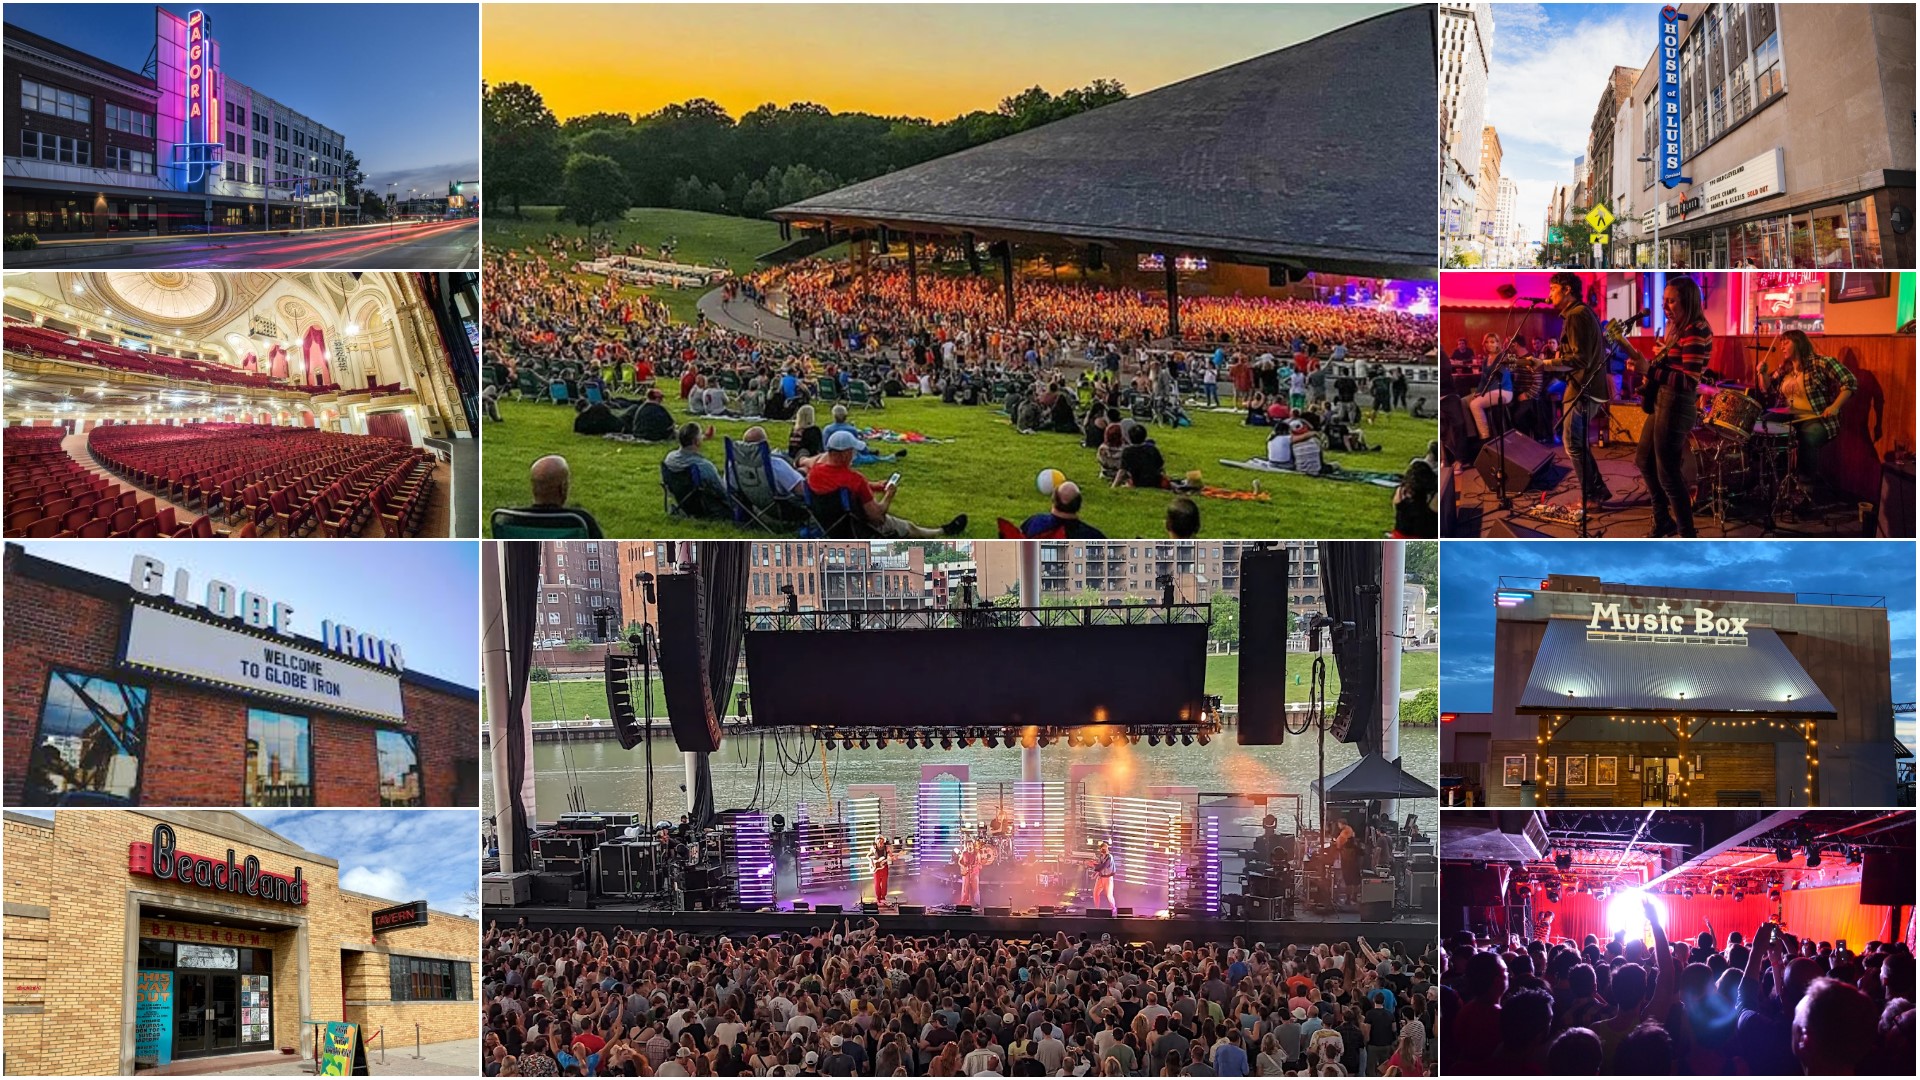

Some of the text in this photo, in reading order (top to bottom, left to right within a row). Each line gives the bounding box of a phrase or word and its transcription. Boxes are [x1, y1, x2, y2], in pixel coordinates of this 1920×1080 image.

[1664, 23, 1677, 84] HOUSE
[190, 27, 202, 118] AGORA
[1666, 102, 1678, 169] BLUES
[1747, 189, 1758, 198] SOLD
[1760, 185, 1768, 193] OUT
[129, 554, 405, 673] GLOBE IRON
[1586, 602, 1749, 635] Music Box
[240, 660, 341, 696] TO GLOBE IRON
[264, 647, 323, 677] WELCOME
[152, 823, 303, 905] Beachland
[375, 909, 415, 926] TAVERN
[152, 924, 260, 945] BALLROOM
[137, 982, 170, 992] WAY
[137, 993, 170, 1002] OUT
